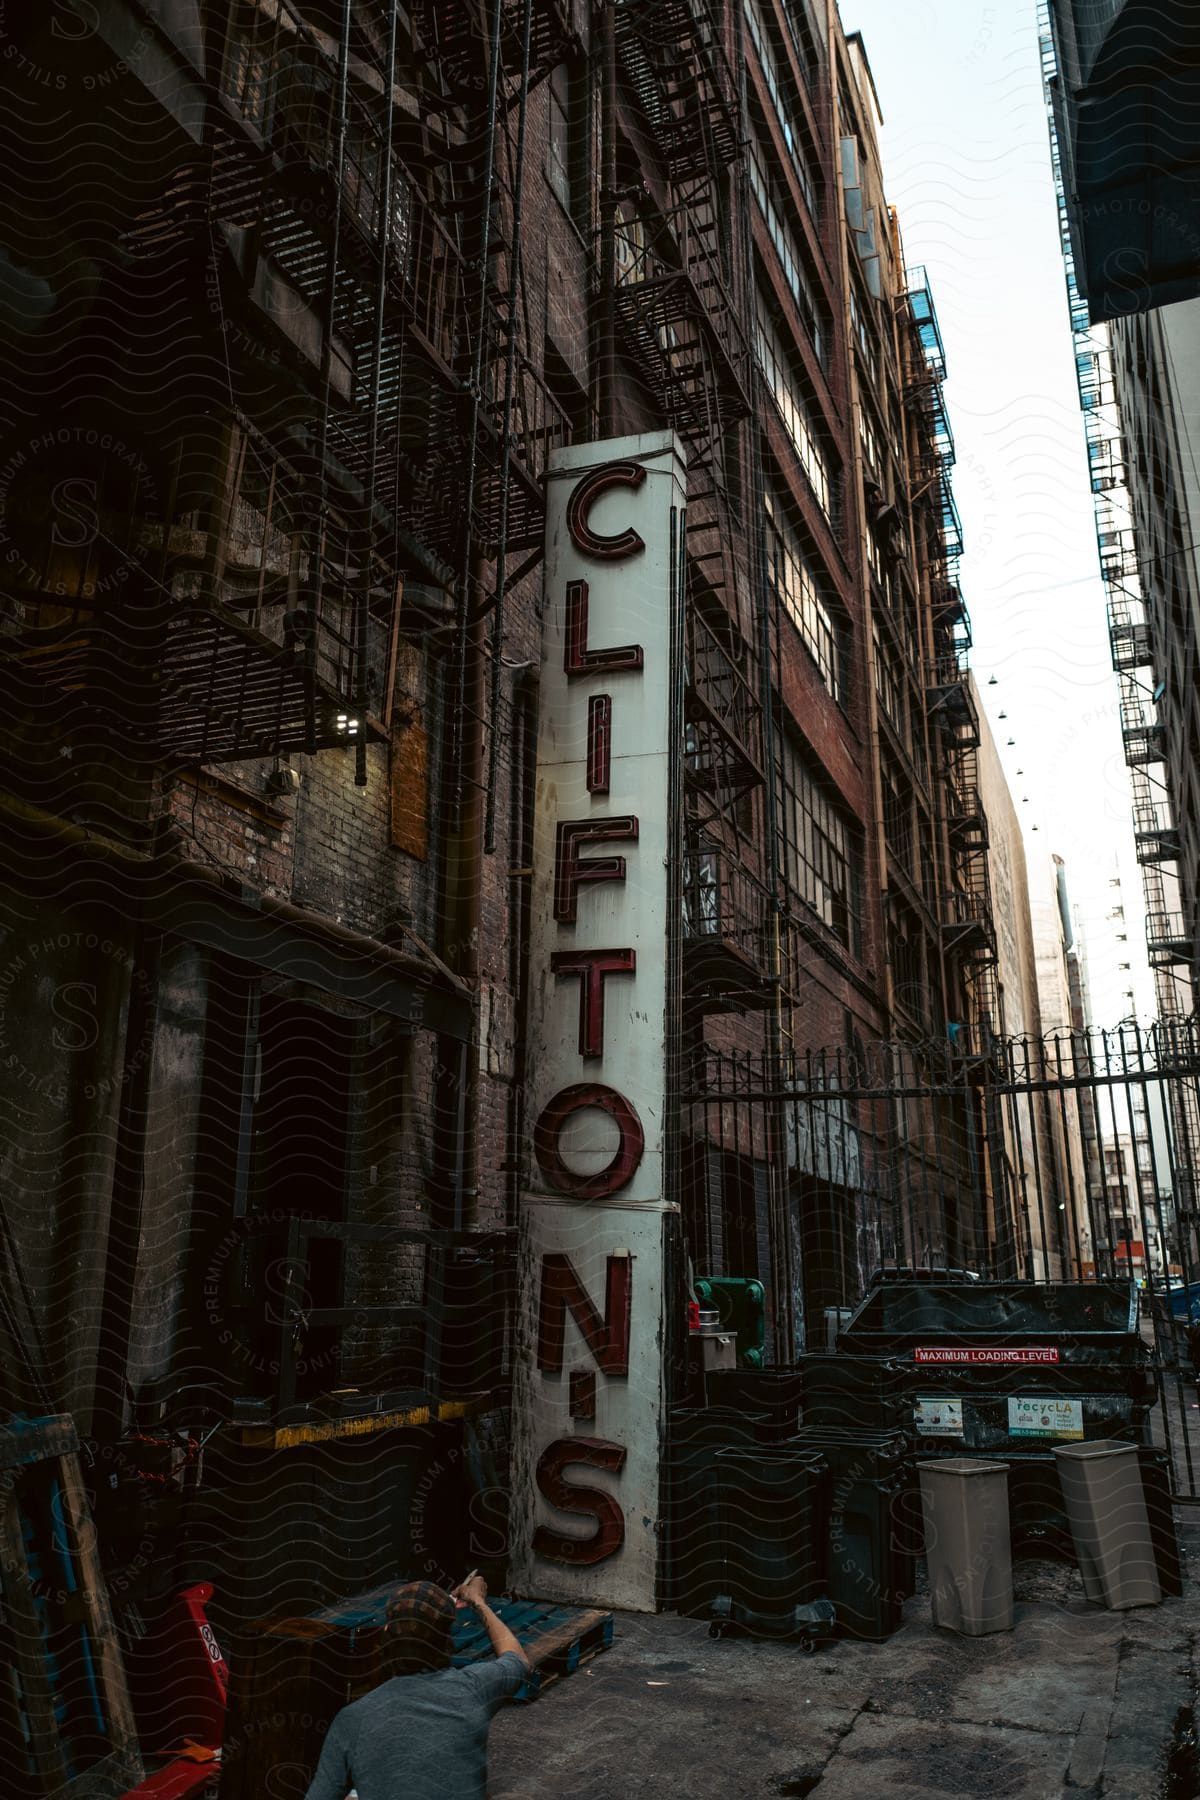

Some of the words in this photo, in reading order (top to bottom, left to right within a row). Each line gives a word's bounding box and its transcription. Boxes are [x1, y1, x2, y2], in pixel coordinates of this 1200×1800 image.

[532, 461, 646, 1567] CLIFTON'S
[920, 1352, 969, 1361] MAXIMUM
[972, 1352, 1019, 1361] LOADING
[1023, 1351, 1056, 1361] LEVEL
